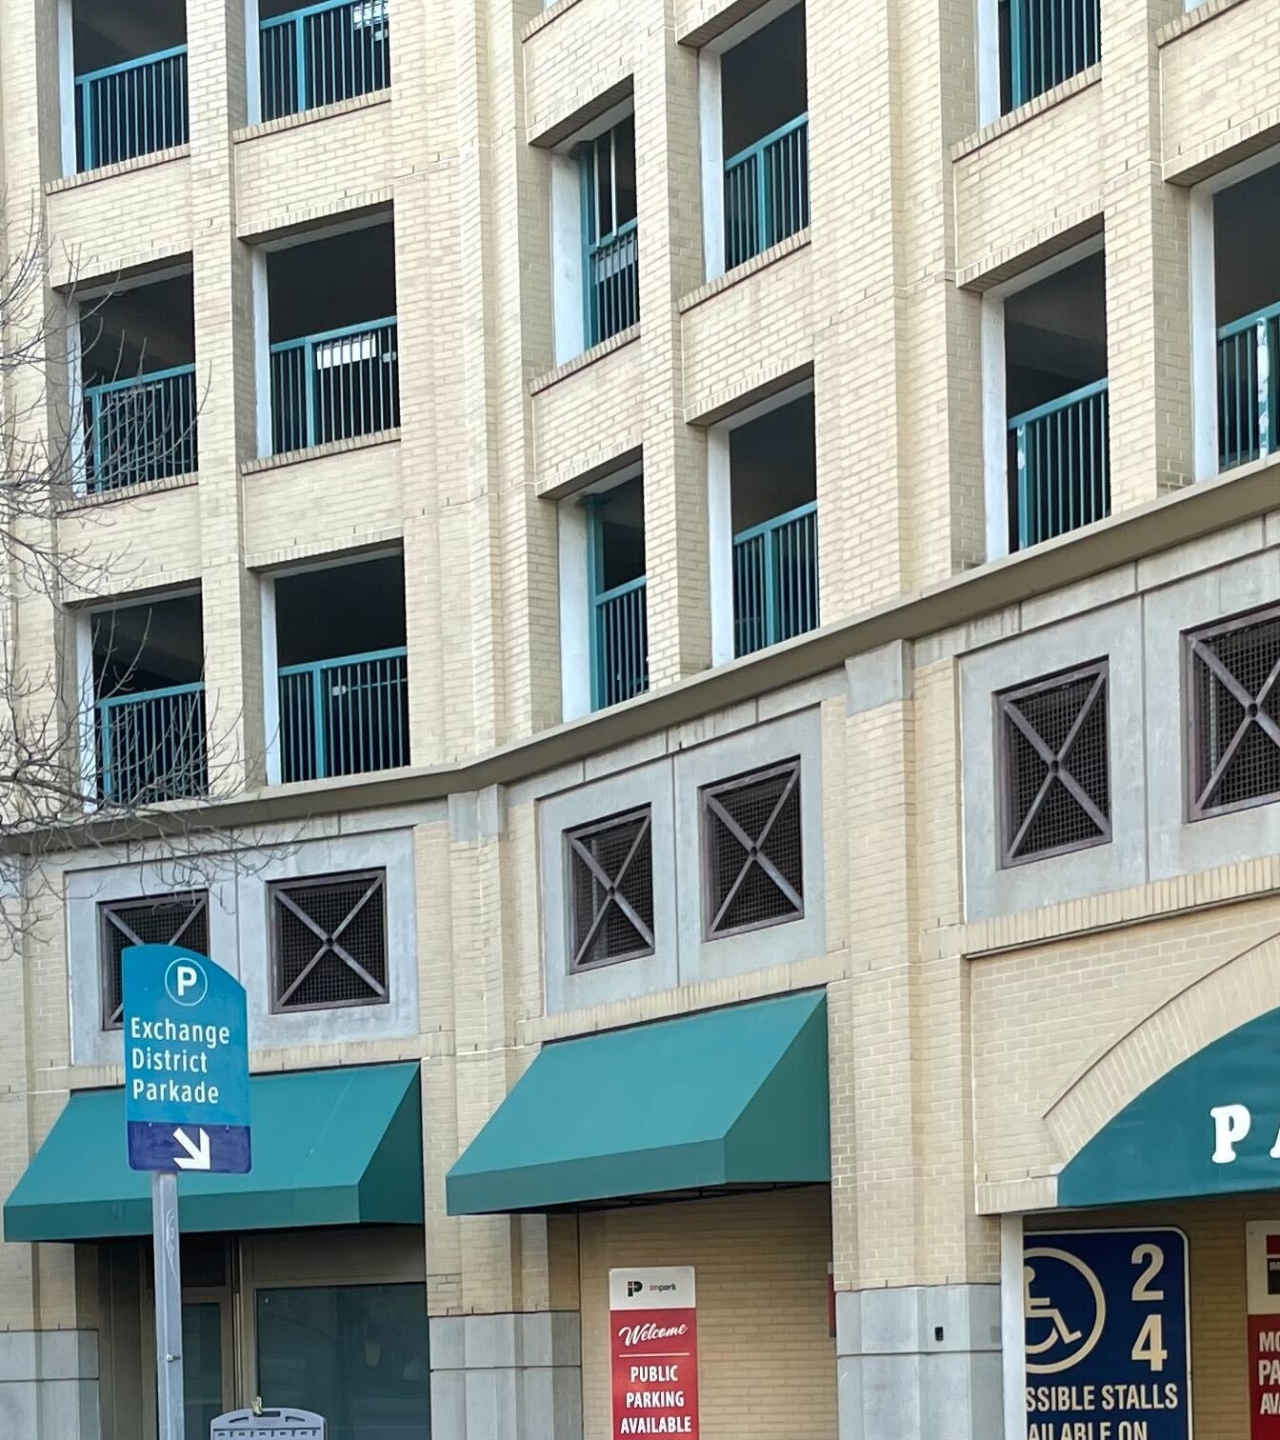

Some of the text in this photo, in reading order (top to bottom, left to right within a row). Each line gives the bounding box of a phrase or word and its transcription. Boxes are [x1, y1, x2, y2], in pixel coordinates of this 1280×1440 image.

[177, 966, 197, 996] P
[131, 1017, 230, 1048] Exchange
[132, 1048, 208, 1073] District
[133, 1079, 219, 1104] Parkade
[1131, 1243, 1164, 1301] 2
[618, 1323, 688, 1346] Welcome
[1131, 1314, 1168, 1371] 4
[630, 1365, 679, 1383] PUBLIC
[626, 1390, 685, 1409] PARKING
[1101, 1383, 1179, 1410] STALLS
[620, 1416, 692, 1434] AVAILABLE
